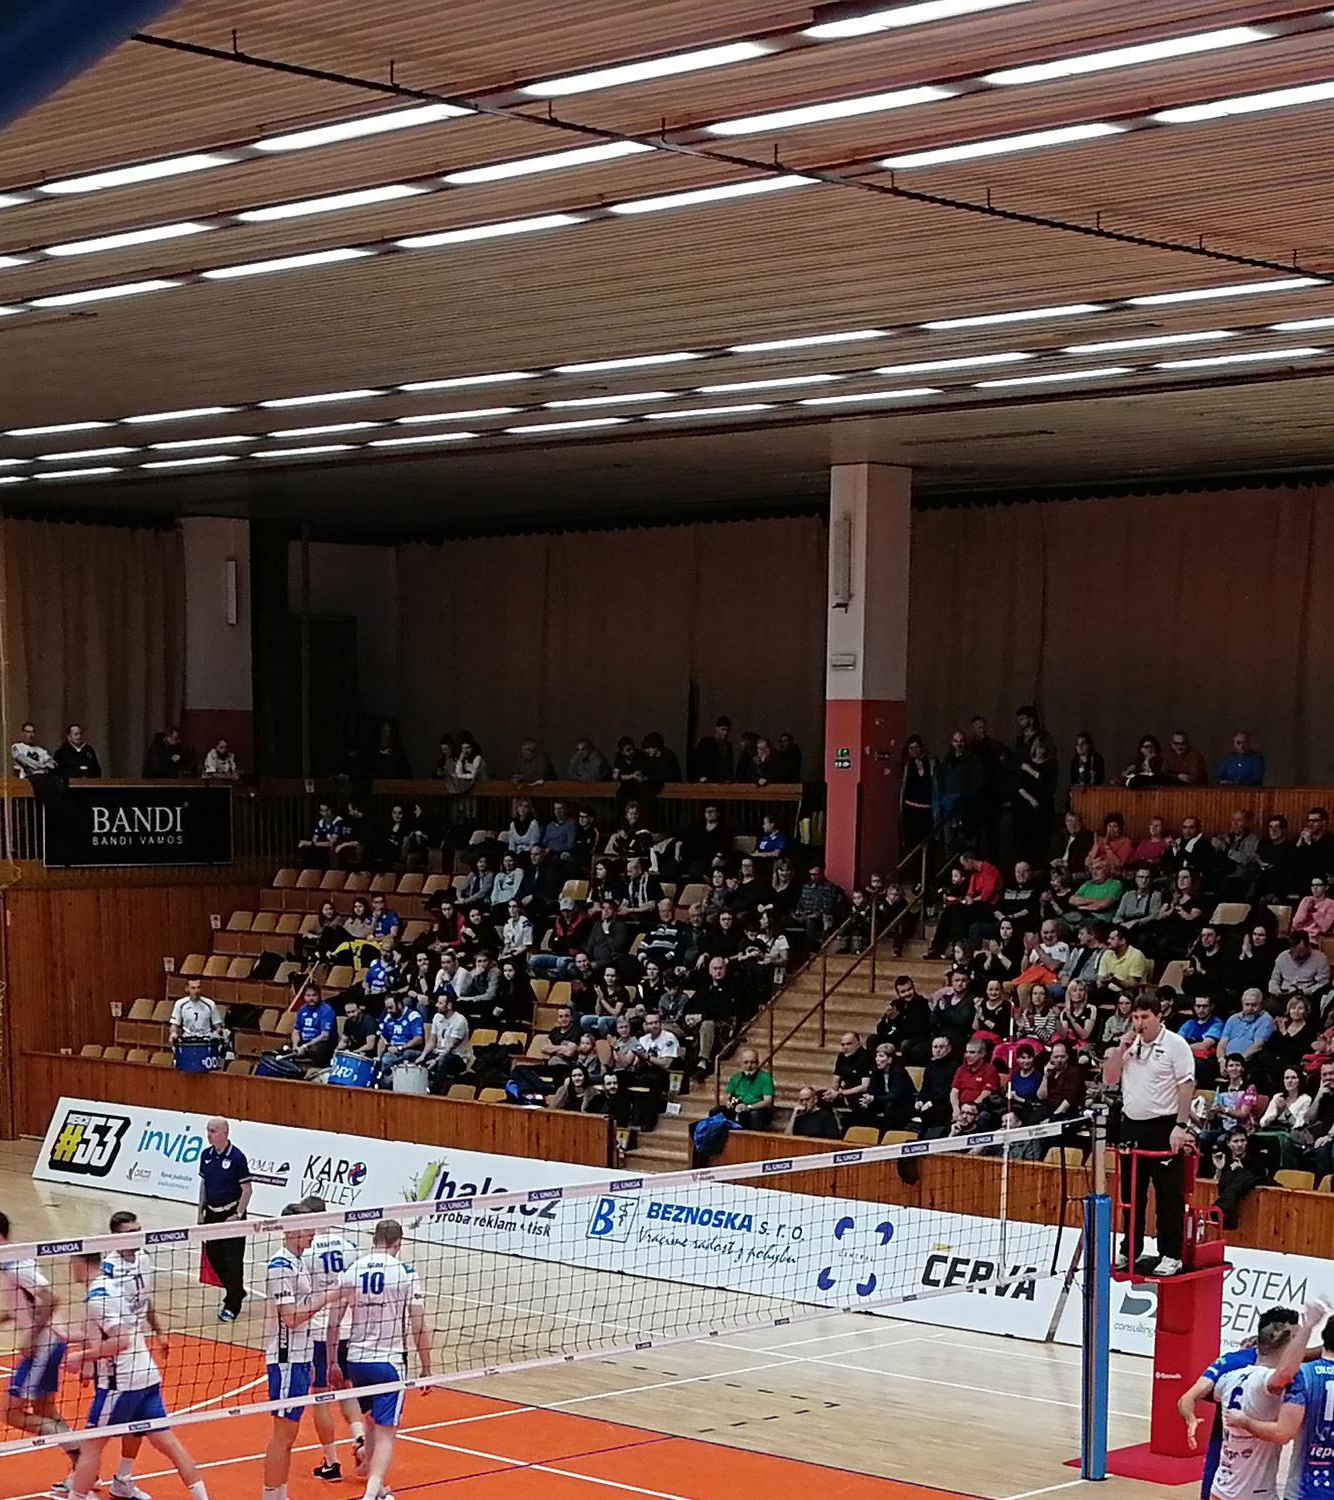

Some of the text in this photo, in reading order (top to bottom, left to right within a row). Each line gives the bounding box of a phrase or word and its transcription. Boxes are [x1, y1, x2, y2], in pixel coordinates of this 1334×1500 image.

[91, 807, 183, 833] BANDI
[92, 835, 184, 845] BANDI VAMOS
[137, 1121, 204, 1163] invia
[473, 1213, 517, 1231] reklam
[528, 1220, 551, 1237] tisk
[646, 1201, 754, 1233] BEZNOSKA
[319, 1250, 344, 1274] 16
[359, 1271, 385, 1295] 10
